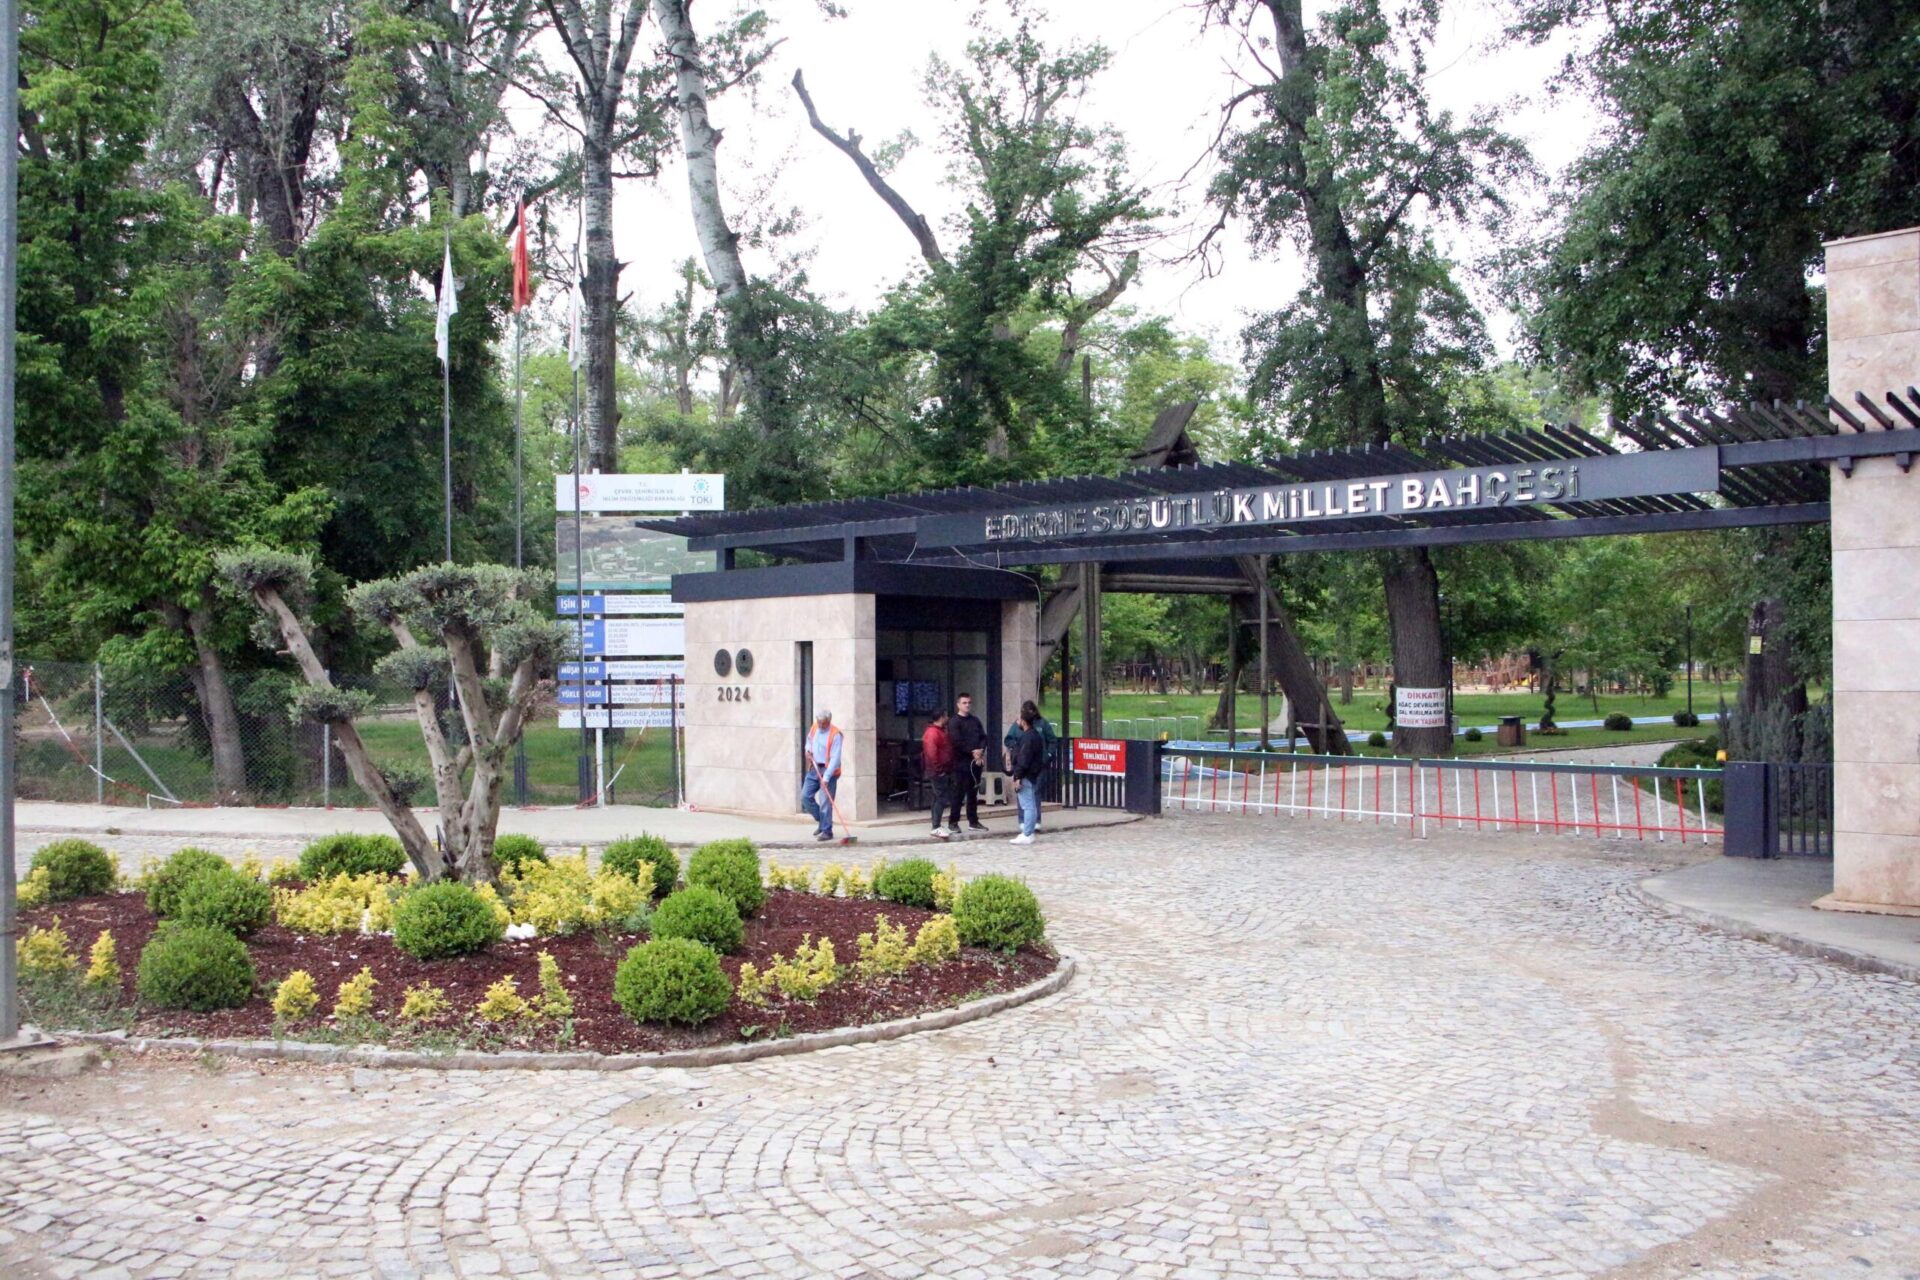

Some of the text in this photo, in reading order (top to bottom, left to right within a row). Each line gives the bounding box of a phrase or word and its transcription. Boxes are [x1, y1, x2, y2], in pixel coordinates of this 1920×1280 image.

[984, 464, 1580, 540] EDİRNE SÖĞÜTLÜK MİLLET BAHÇESİ
[717, 686, 751, 702] 2024
